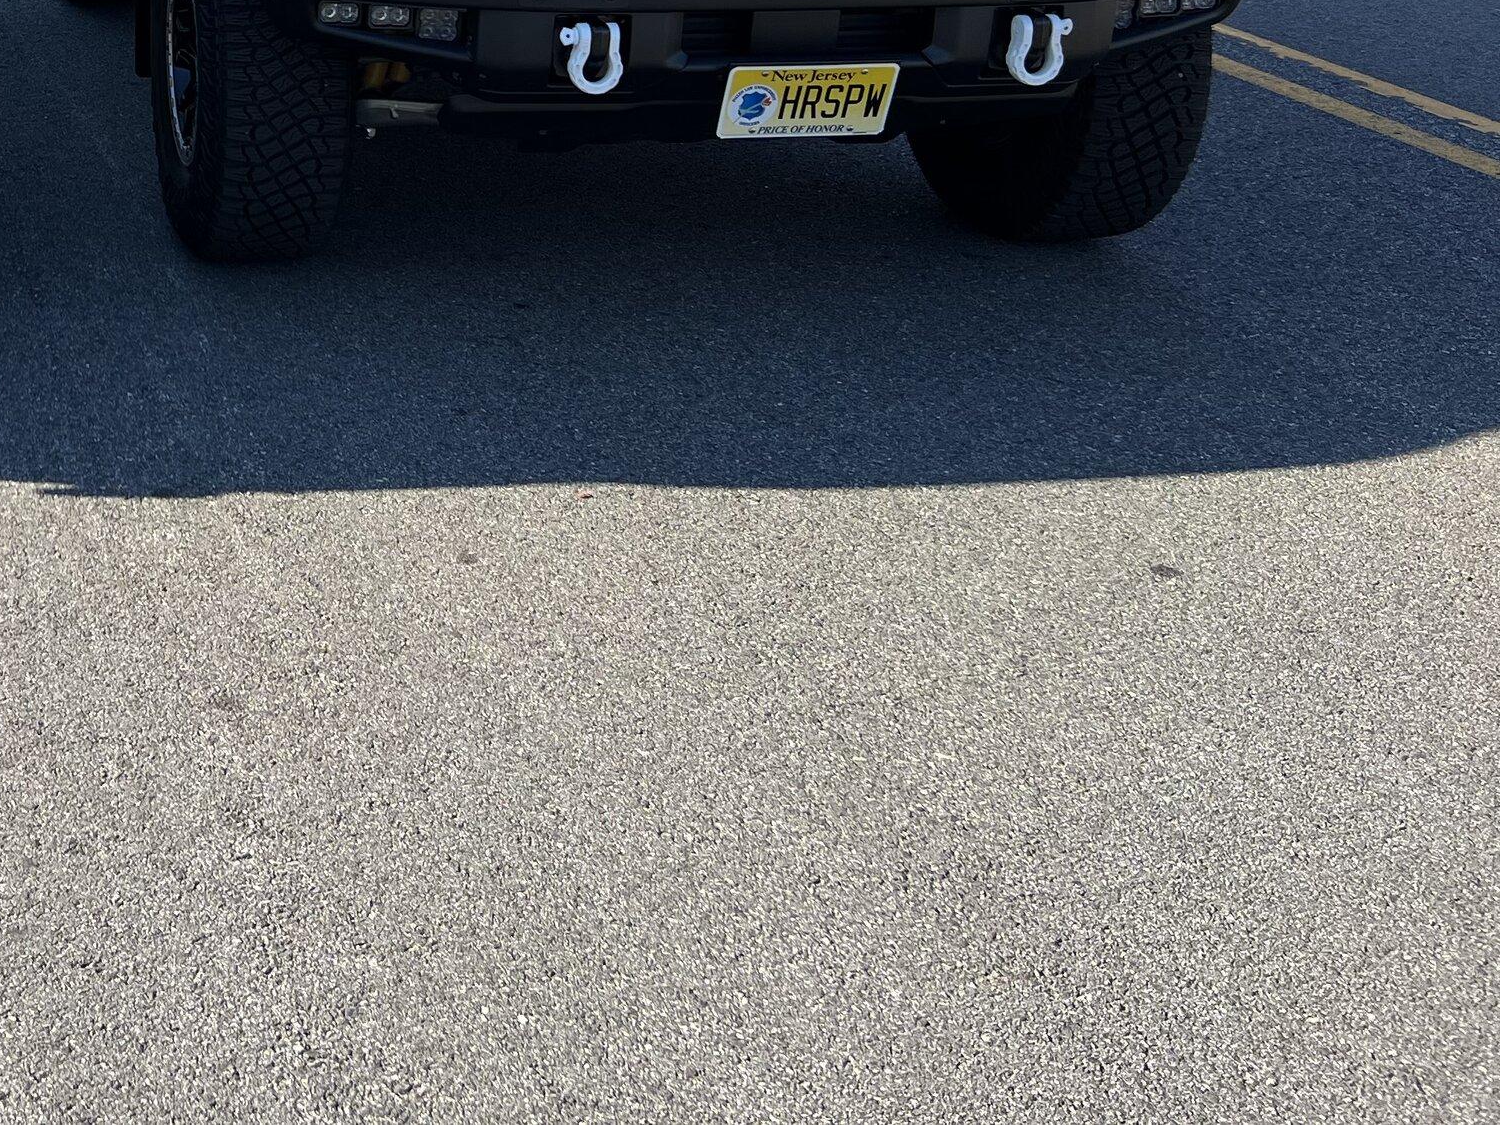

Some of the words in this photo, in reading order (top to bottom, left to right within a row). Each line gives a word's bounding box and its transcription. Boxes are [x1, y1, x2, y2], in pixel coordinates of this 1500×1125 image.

[771, 70, 808, 82] New
[808, 69, 857, 83] Jersey
[777, 83, 888, 120] HRSPW
[757, 126, 788, 135] PRICE
[790, 125, 804, 134] OF
[805, 124, 845, 133] HONOR
